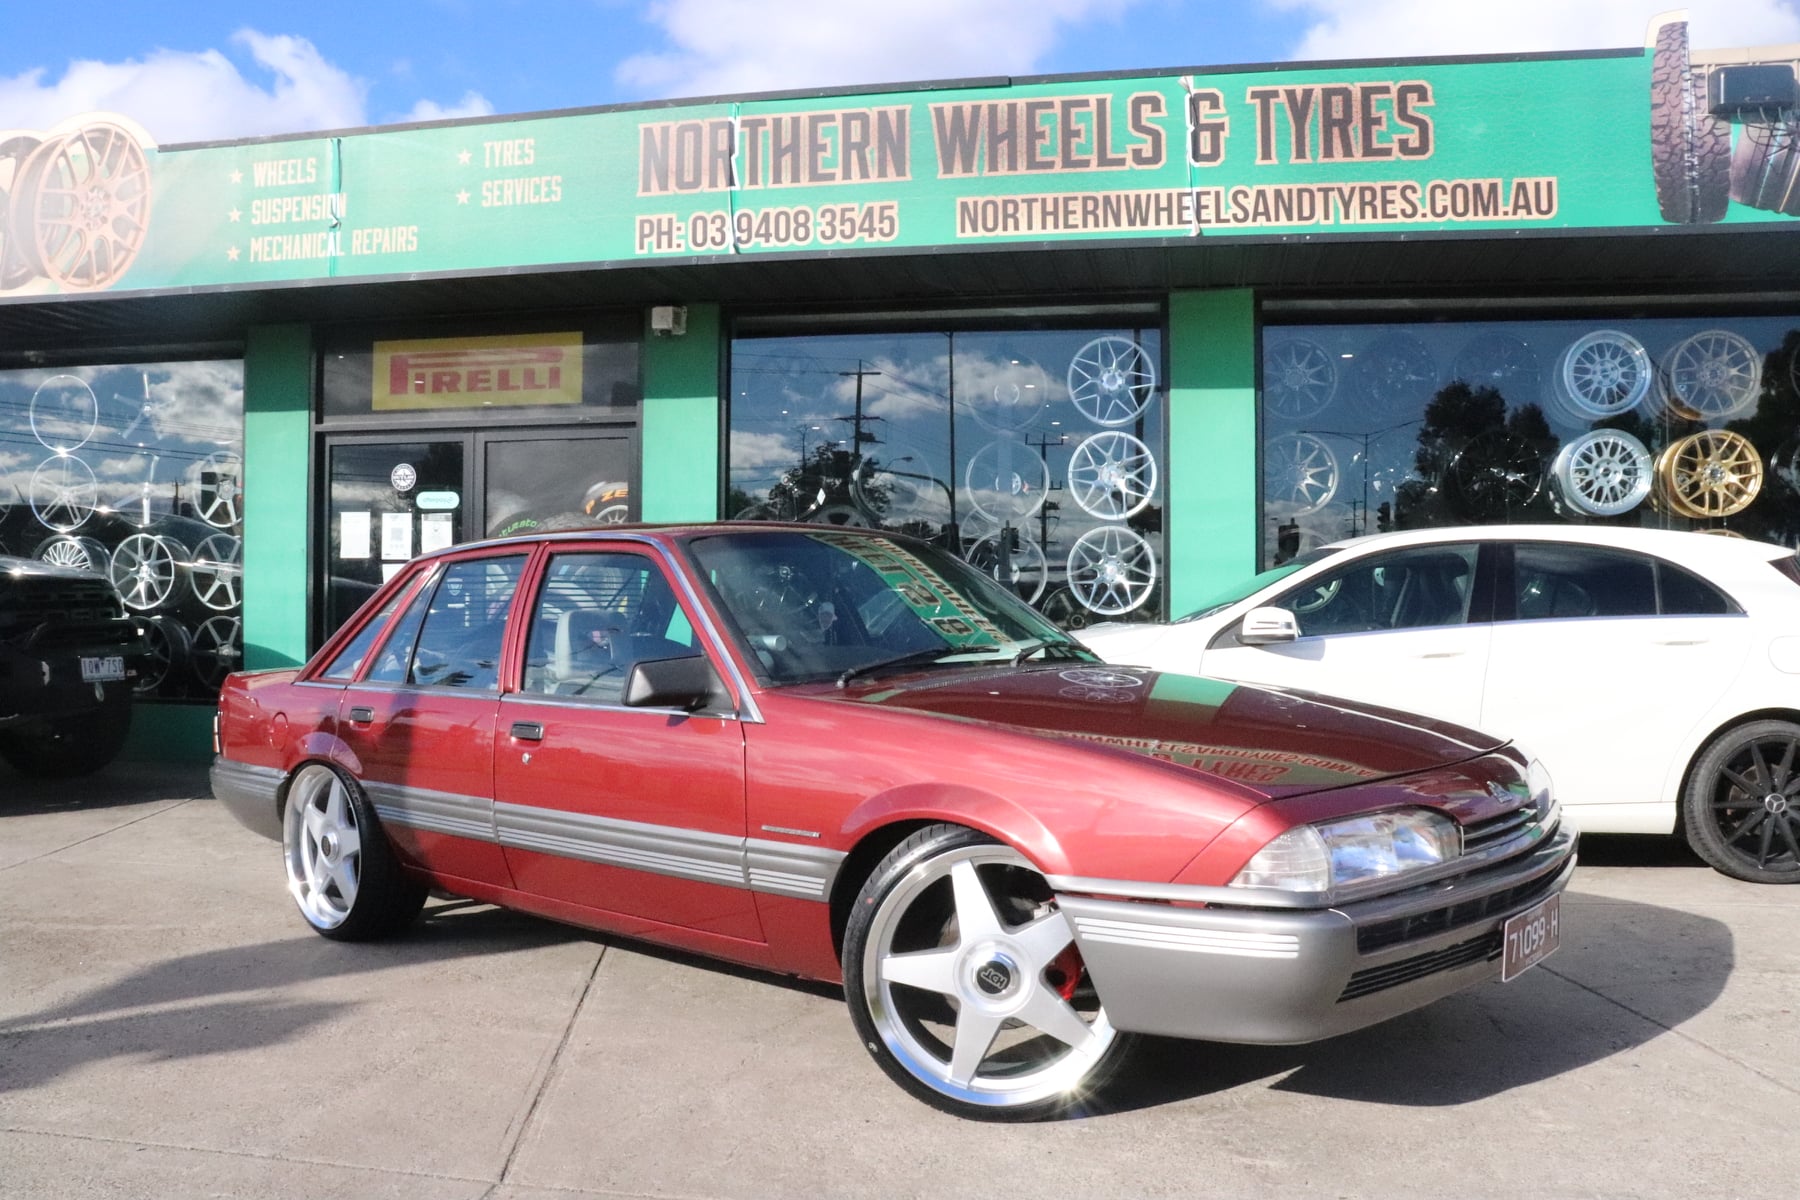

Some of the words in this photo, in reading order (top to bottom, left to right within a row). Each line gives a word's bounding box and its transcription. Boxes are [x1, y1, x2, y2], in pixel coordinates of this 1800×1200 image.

[483, 138, 536, 168] TYRES
[639, 106, 910, 195] NORTHERN
[931, 93, 1166, 177] WHEELS
[1187, 90, 1228, 166] &
[1248, 81, 1433, 165] TYRES
[253, 157, 317, 188] WHEELS
[481, 175, 562, 208] SERVICES
[637, 216, 683, 251] PH:
[691, 213, 727, 249] 03
[736, 208, 810, 247] 9408
[819, 205, 896, 242] 3545
[959, 180, 1554, 234] NORTHERNWHEELSANDTYRES.COM.AU
[249, 231, 345, 263] MECHANICAL
[351, 225, 418, 255] REPAIRS
[389, 345, 564, 396] PIRELLI
